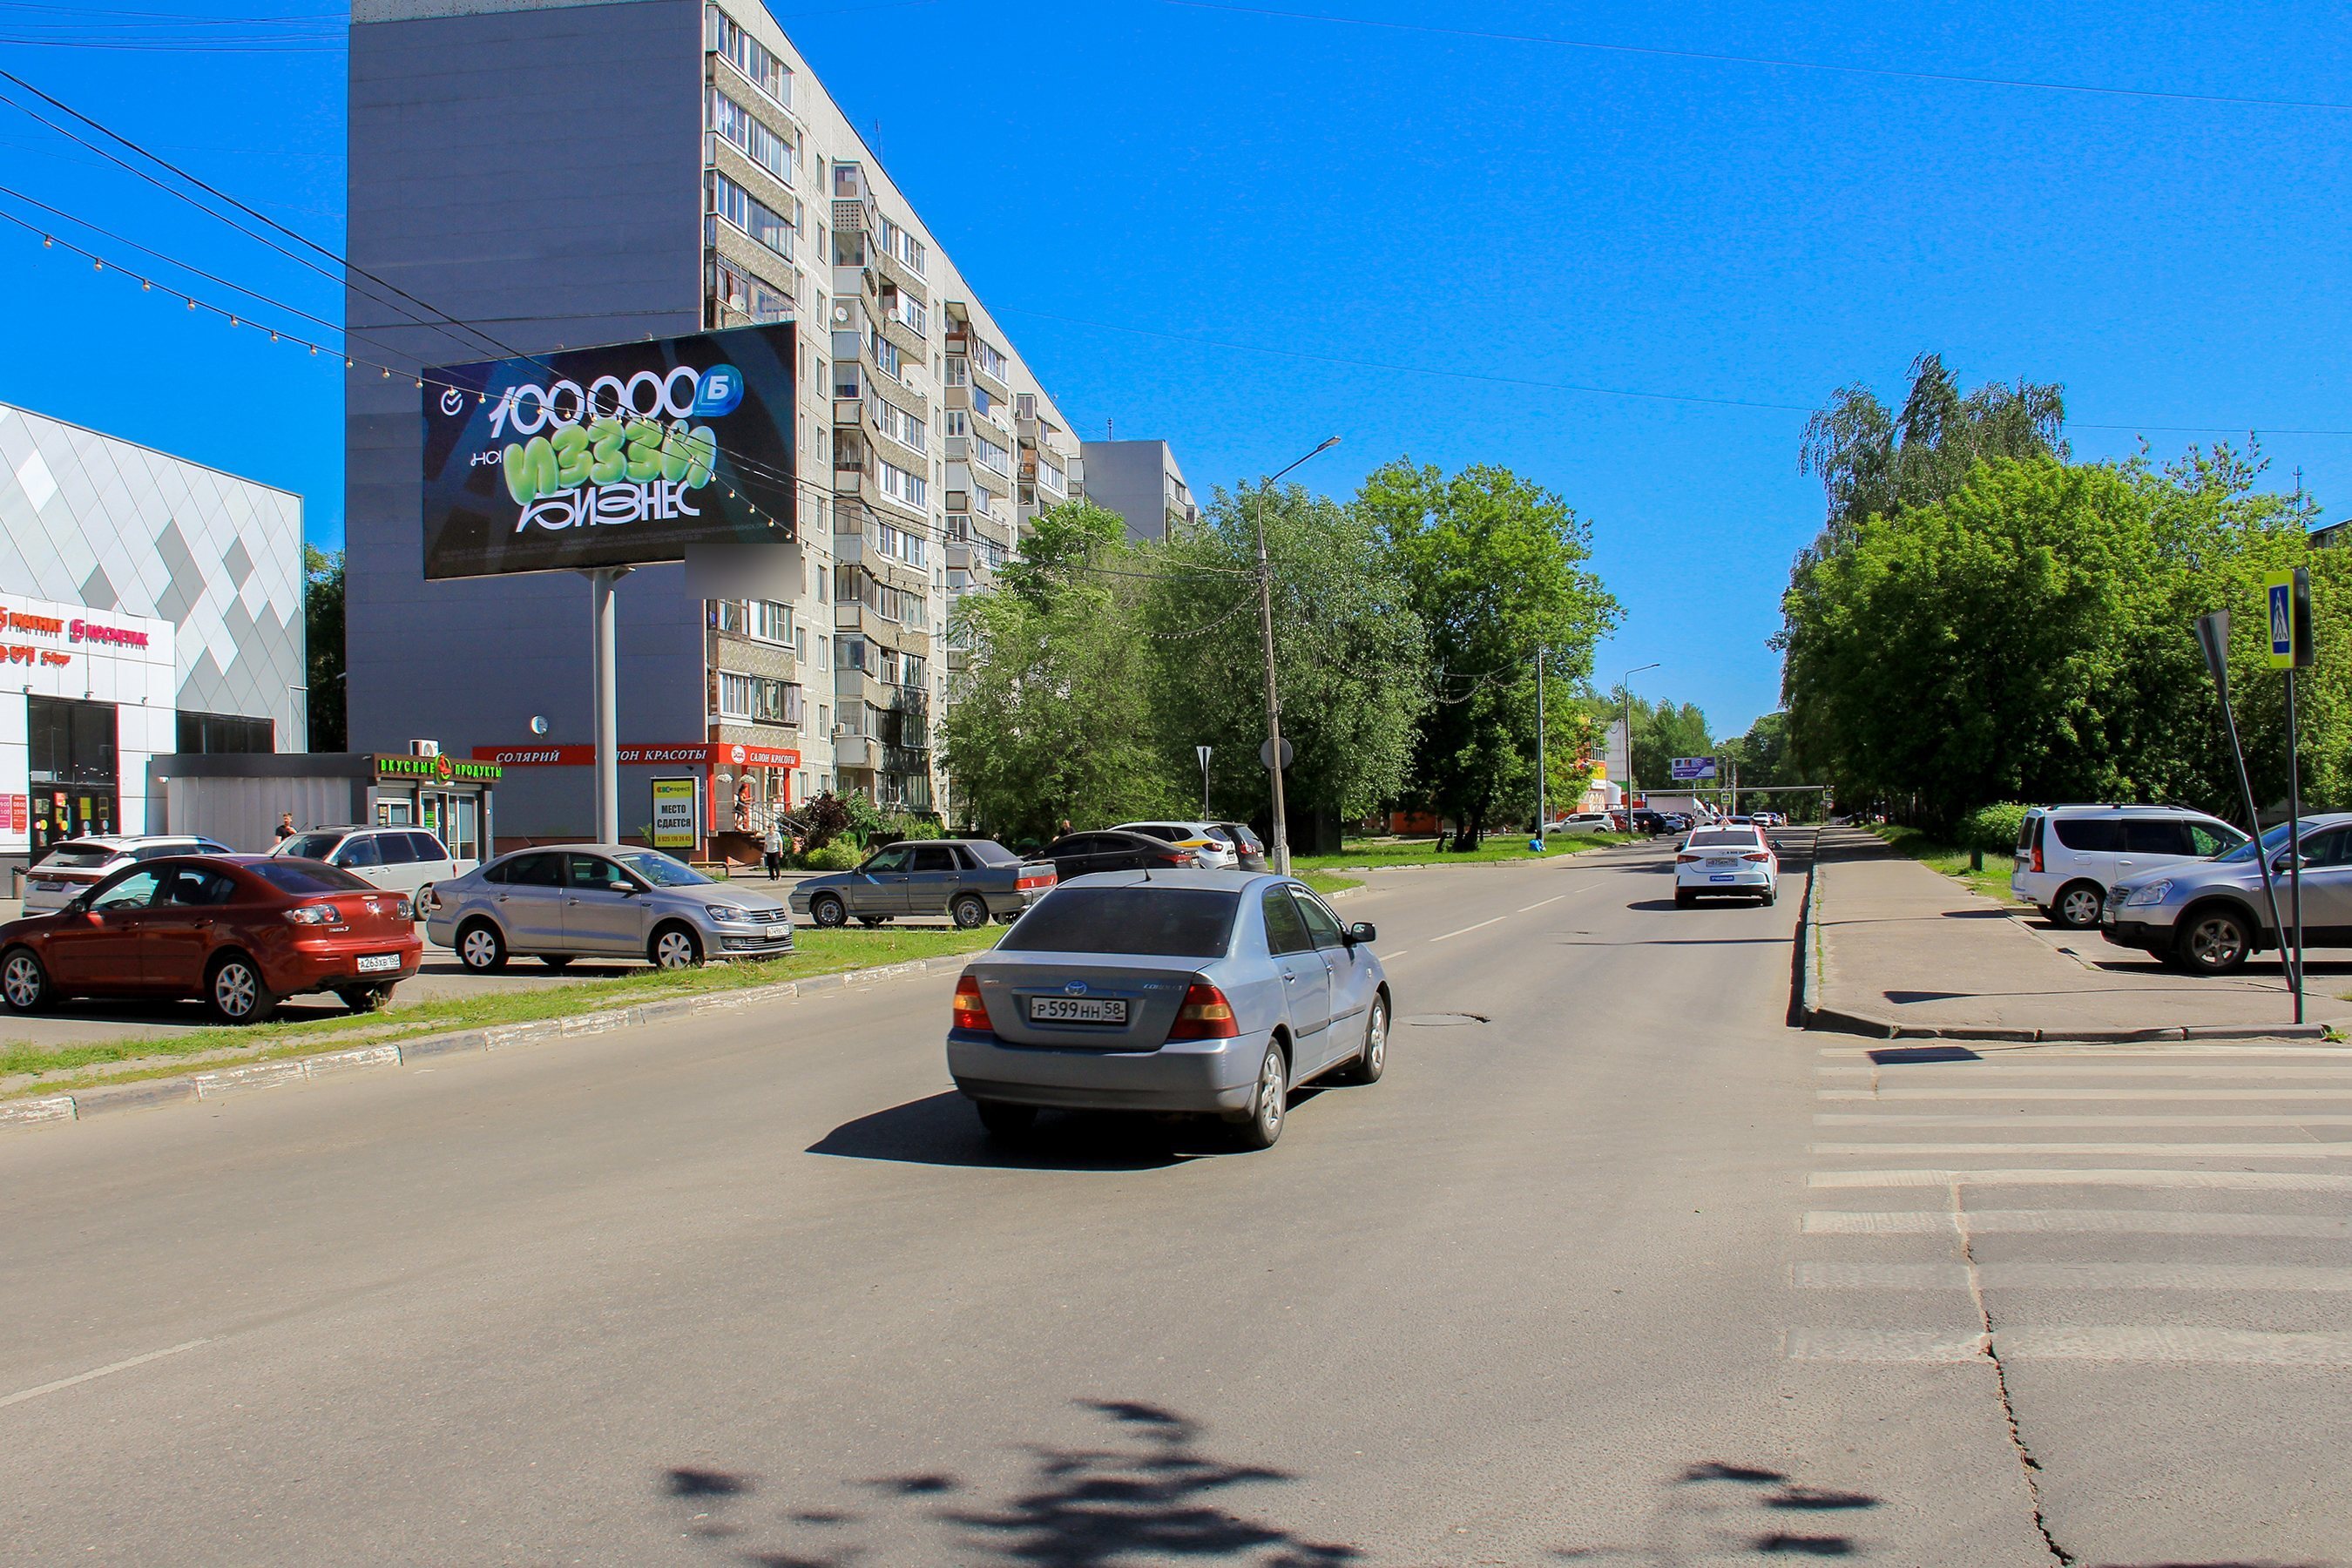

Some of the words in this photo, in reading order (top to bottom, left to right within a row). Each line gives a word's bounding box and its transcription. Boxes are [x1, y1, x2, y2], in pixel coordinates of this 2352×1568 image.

[516, 479, 700, 532] БИЗНЕС
[9, 612, 64, 634] МАГНИТ
[86, 624, 149, 647] КОСМЕТИК
[496, 749, 561, 763] СОЛЯРИЙ
[644, 749, 707, 761] КРАСОТЫ
[750, 752, 769, 763] САЛОН
[770, 754, 796, 765] КРАСОТЫ
[381, 759, 435, 774] ВКУСНЫЕ
[456, 764, 502, 778] ПРОДУКТЫ
[661, 804, 686, 814] МЕСТО
[657, 818, 691, 828] СДАЕТСЯ
[1104, 1003, 1120, 1015] 58
